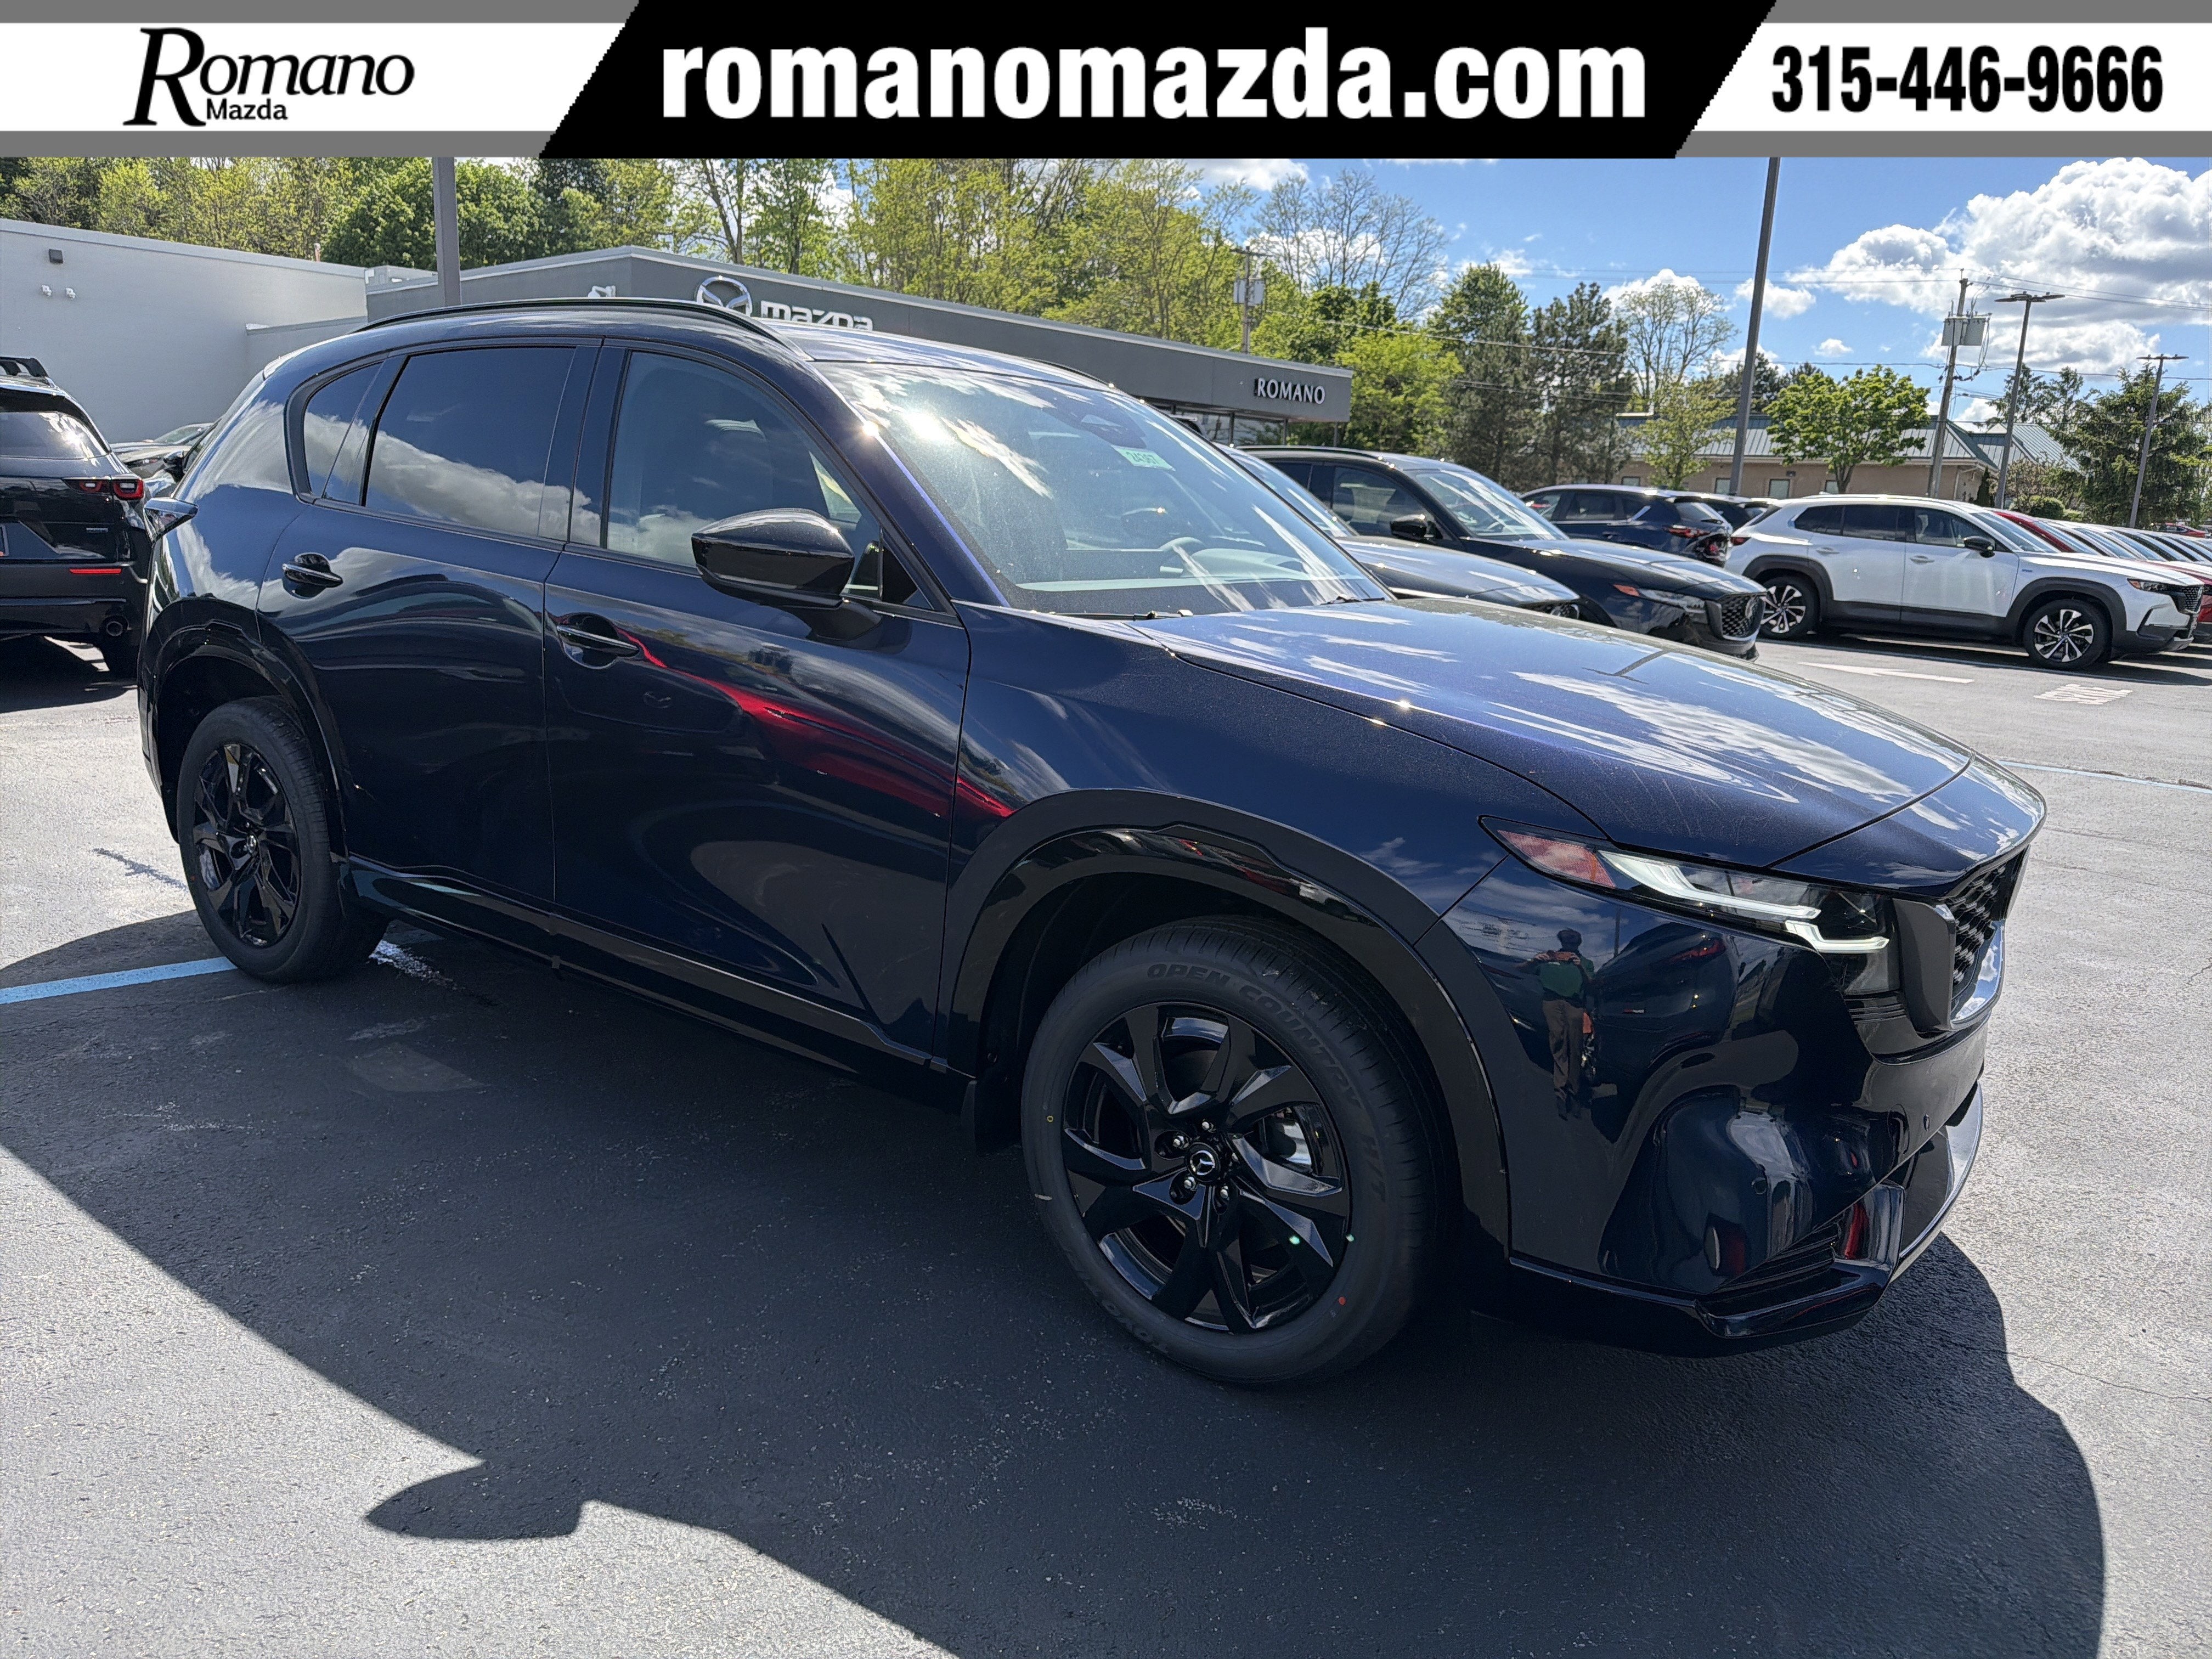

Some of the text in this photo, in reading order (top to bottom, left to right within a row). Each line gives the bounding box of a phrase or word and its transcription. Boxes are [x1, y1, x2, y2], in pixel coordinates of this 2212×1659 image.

[1256, 377, 1325, 404] ROMANO
[1147, 963, 1231, 988] OPEN
[1239, 984, 1362, 1109] COUNTRY
